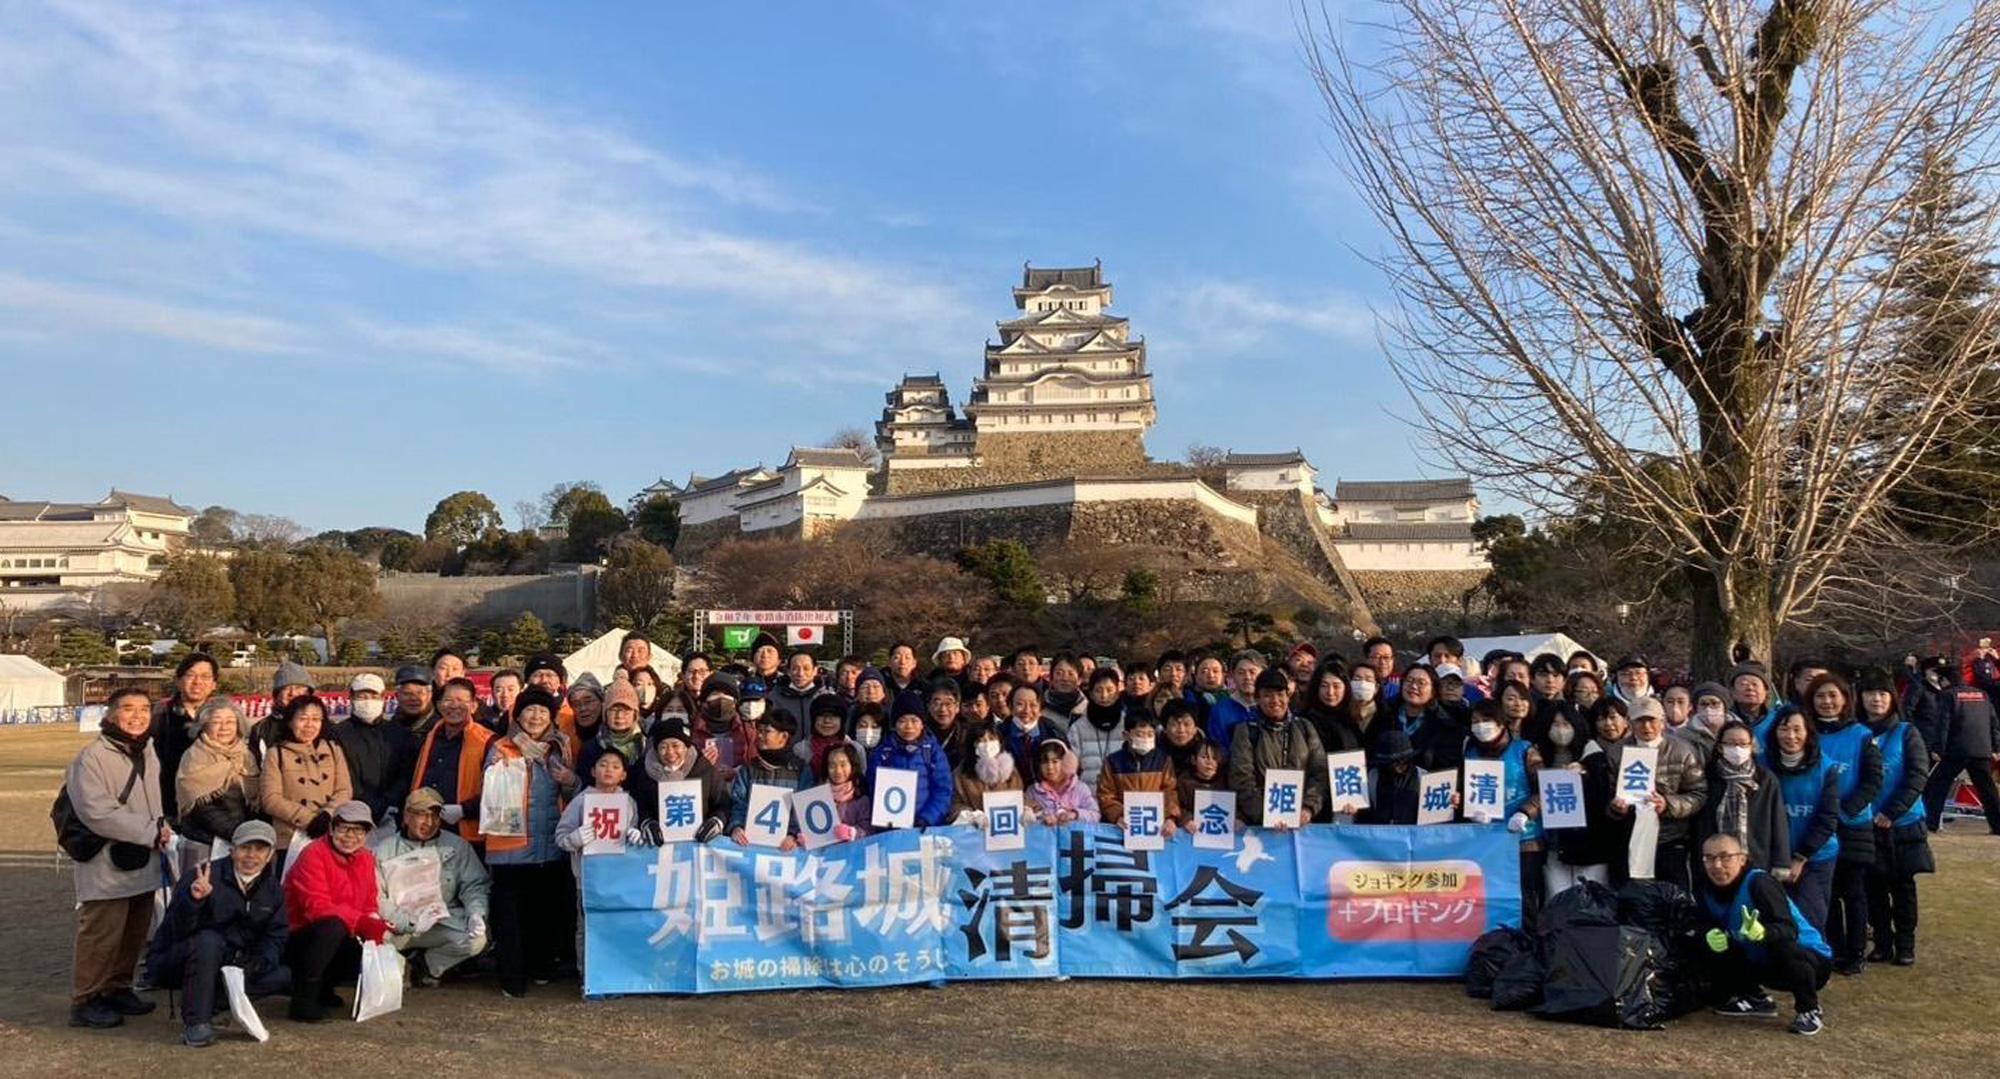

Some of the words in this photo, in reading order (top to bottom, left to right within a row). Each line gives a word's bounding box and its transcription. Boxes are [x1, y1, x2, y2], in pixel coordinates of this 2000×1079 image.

[1333, 765, 1362, 797] 路
[1470, 773, 1498, 805] 清
[1623, 759, 1651, 792] 会
[664, 794, 696, 828] 第
[883, 786, 907, 814] 0
[1268, 782, 1298, 814] 姫
[1422, 783, 1451, 812] 城
[1544, 782, 1577, 814] 掃
[588, 806, 621, 841] 祝
[754, 799, 782, 834] 4
[805, 800, 833, 835] 0
[989, 805, 1019, 837] 回
[1129, 805, 1160, 837] 記
[1199, 803, 1229, 835] 念
[1354, 872, 1458, 889] ジョギング参加
[710, 948, 949, 981] お城の掃除は心のそうじ
